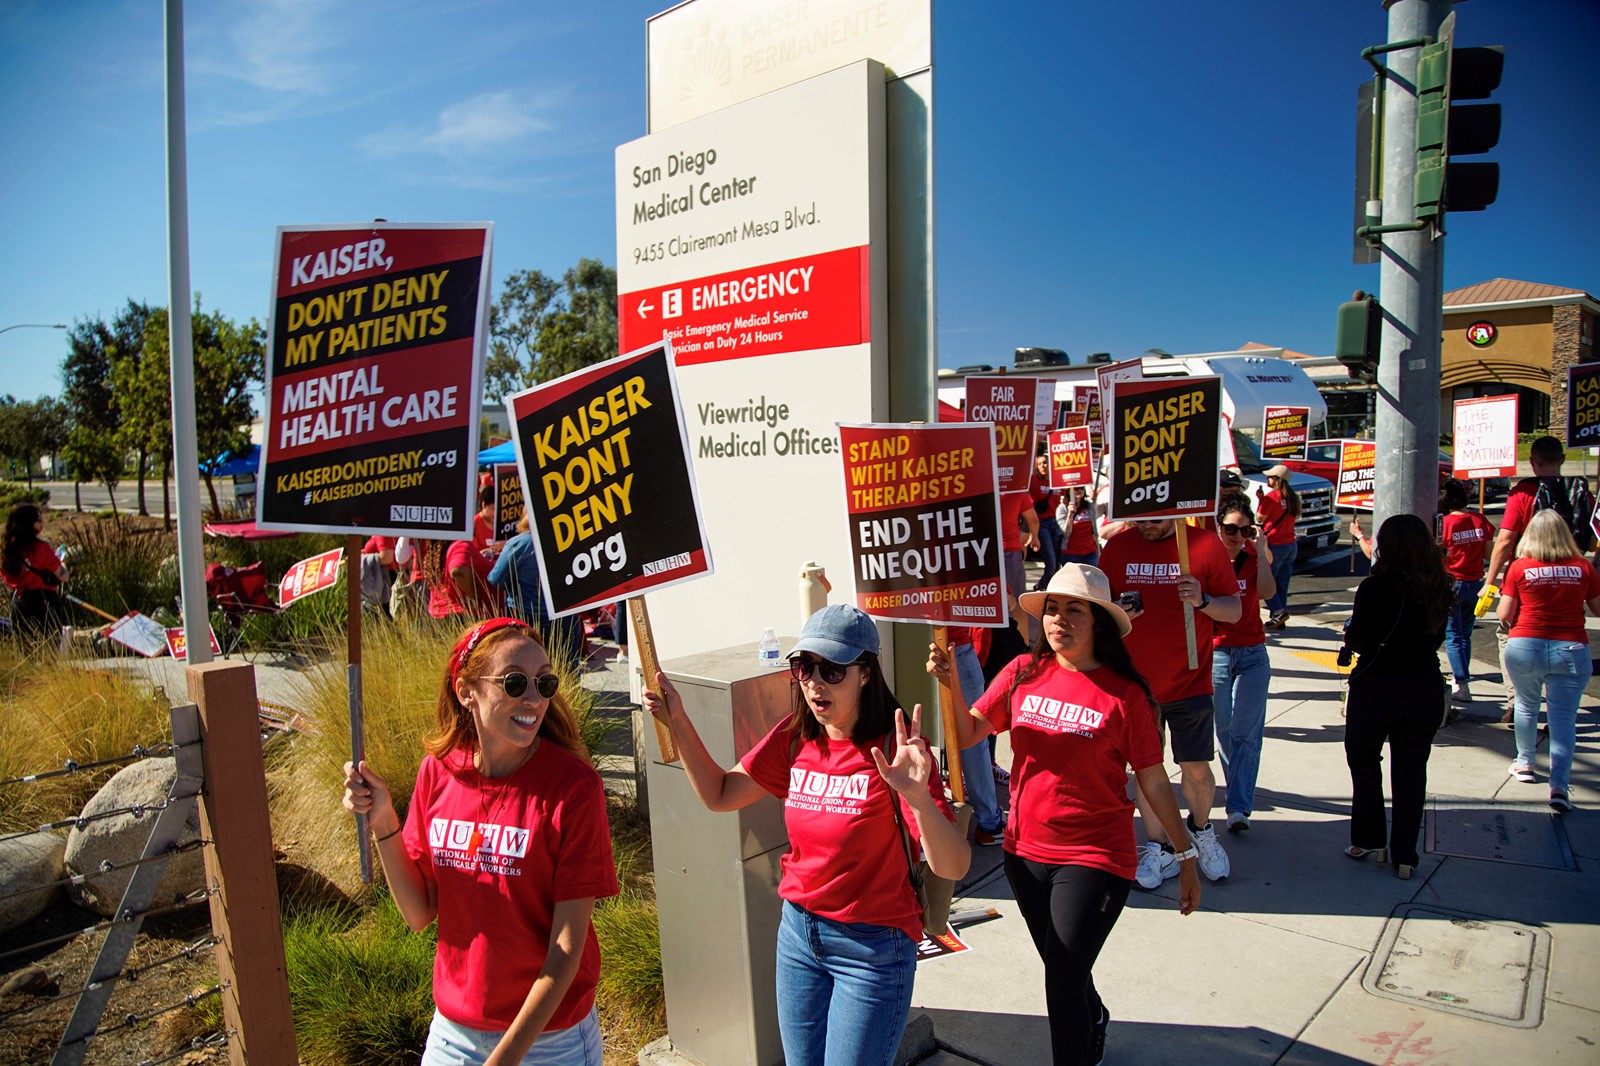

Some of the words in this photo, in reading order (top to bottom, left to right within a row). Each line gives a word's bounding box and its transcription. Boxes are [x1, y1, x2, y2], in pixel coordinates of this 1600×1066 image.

[741, 1, 811, 46] KAISER
[742, 2, 889, 78] PERMANENTE
[633, 165, 661, 188] San
[668, 149, 716, 175] Diego
[633, 185, 693, 225] Medical
[700, 176, 756, 206] Center
[633, 242, 664, 265] 9455
[669, 227, 737, 257] Clairemont
[742, 218, 779, 239] Mesa
[785, 202, 821, 232] Blvd.
[291, 237, 394, 287] KAISER,
[287, 286, 367, 332] DON'T
[372, 269, 450, 312] DENY
[692, 266, 814, 311] EMERGENCY
[284, 331, 325, 367] MY
[328, 305, 448, 357] PATIENTS
[663, 327, 683, 340] Basic
[685, 322, 731, 337] Emergency
[734, 311, 770, 328] Medical
[773, 308, 808, 322] Service
[672, 341, 701, 356] ysician
[703, 341, 714, 350] on
[717, 337, 737, 350] Duty
[740, 333, 752, 345] 24
[755, 331, 783, 343] Hours
[281, 365, 384, 414] MENTAL
[991, 386, 1015, 402] FAIR
[1576, 393, 1600, 411] DO
[280, 402, 375, 450] HEALTH
[381, 385, 458, 428] CARE
[533, 375, 653, 469] KAISER
[697, 396, 789, 428] Viewridge
[972, 405, 1031, 421] CONTRACT
[1124, 390, 1206, 432] KAISER
[1286, 415, 1302, 423] DENY
[1459, 408, 1488, 422] THE
[1576, 407, 1600, 427] DEN
[995, 425, 1028, 450] OW
[1061, 433, 1076, 442] FAIR
[1266, 431, 1290, 439] MENTAL
[1277, 421, 1302, 430] PATIENTS
[1457, 422, 1493, 435] MATH
[699, 431, 767, 458] Medical
[773, 427, 838, 456] Offices
[849, 435, 910, 463] STAND
[1052, 440, 1087, 453] CONTRACT
[1124, 420, 1190, 459] DONT
[1266, 437, 1288, 446] HEALTH
[1289, 434, 1304, 443] CARE
[1344, 444, 1363, 453] STAND
[1053, 451, 1087, 467] NOW
[1124, 448, 1185, 485] DENY
[1343, 452, 1357, 461] WITH
[1358, 450, 1375, 459] KAISE
[1463, 446, 1514, 462] MATHING
[276, 449, 458, 494] KAISERDONTDENY.org
[541, 427, 631, 511] DONT
[851, 461, 897, 487] WITH
[902, 447, 974, 480] KAISER
[1342, 470, 1358, 482] END
[1358, 468, 1375, 480] THE
[303, 471, 426, 506] #KAISERDONTDENY
[501, 476, 520, 493] KAI
[852, 474, 966, 509] THERAPISTS
[1124, 480, 1170, 505] .org
[501, 491, 523, 508] DON
[1176, 500, 1207, 509] NUHW
[390, 505, 453, 524] NUHW
[551, 473, 634, 553] DENY
[858, 517, 911, 548] END
[917, 505, 974, 541] THE
[564, 531, 628, 586] .org
[642, 552, 692, 577] NUHW
[860, 537, 990, 581] INEQUITY
[1126, 563, 1181, 576] NUHW
[1524, 566, 1582, 580] NUHW
[865, 582, 998, 609] KAISERDONTDENY.ORG
[952, 606, 997, 617] NUHW
[1020, 695, 1103, 728] NUHW
[1022, 712, 1056, 725] NATIONAL
[1057, 720, 1078, 729] UNION
[1016, 716, 1058, 731] HEALTHCARE
[1061, 726, 1094, 739] WORKERS
[789, 768, 870, 800] NUHW
[789, 792, 820, 803] NATIONAL
[821, 797, 844, 806] UNION
[825, 806, 861, 815] WORKERS
[430, 818, 529, 858] NUHW
[434, 857, 476, 871] ALTHCARE
[480, 862, 521, 876] WORKERS
[473, 852, 498, 864] UNION
[502, 857, 514, 866] OF
